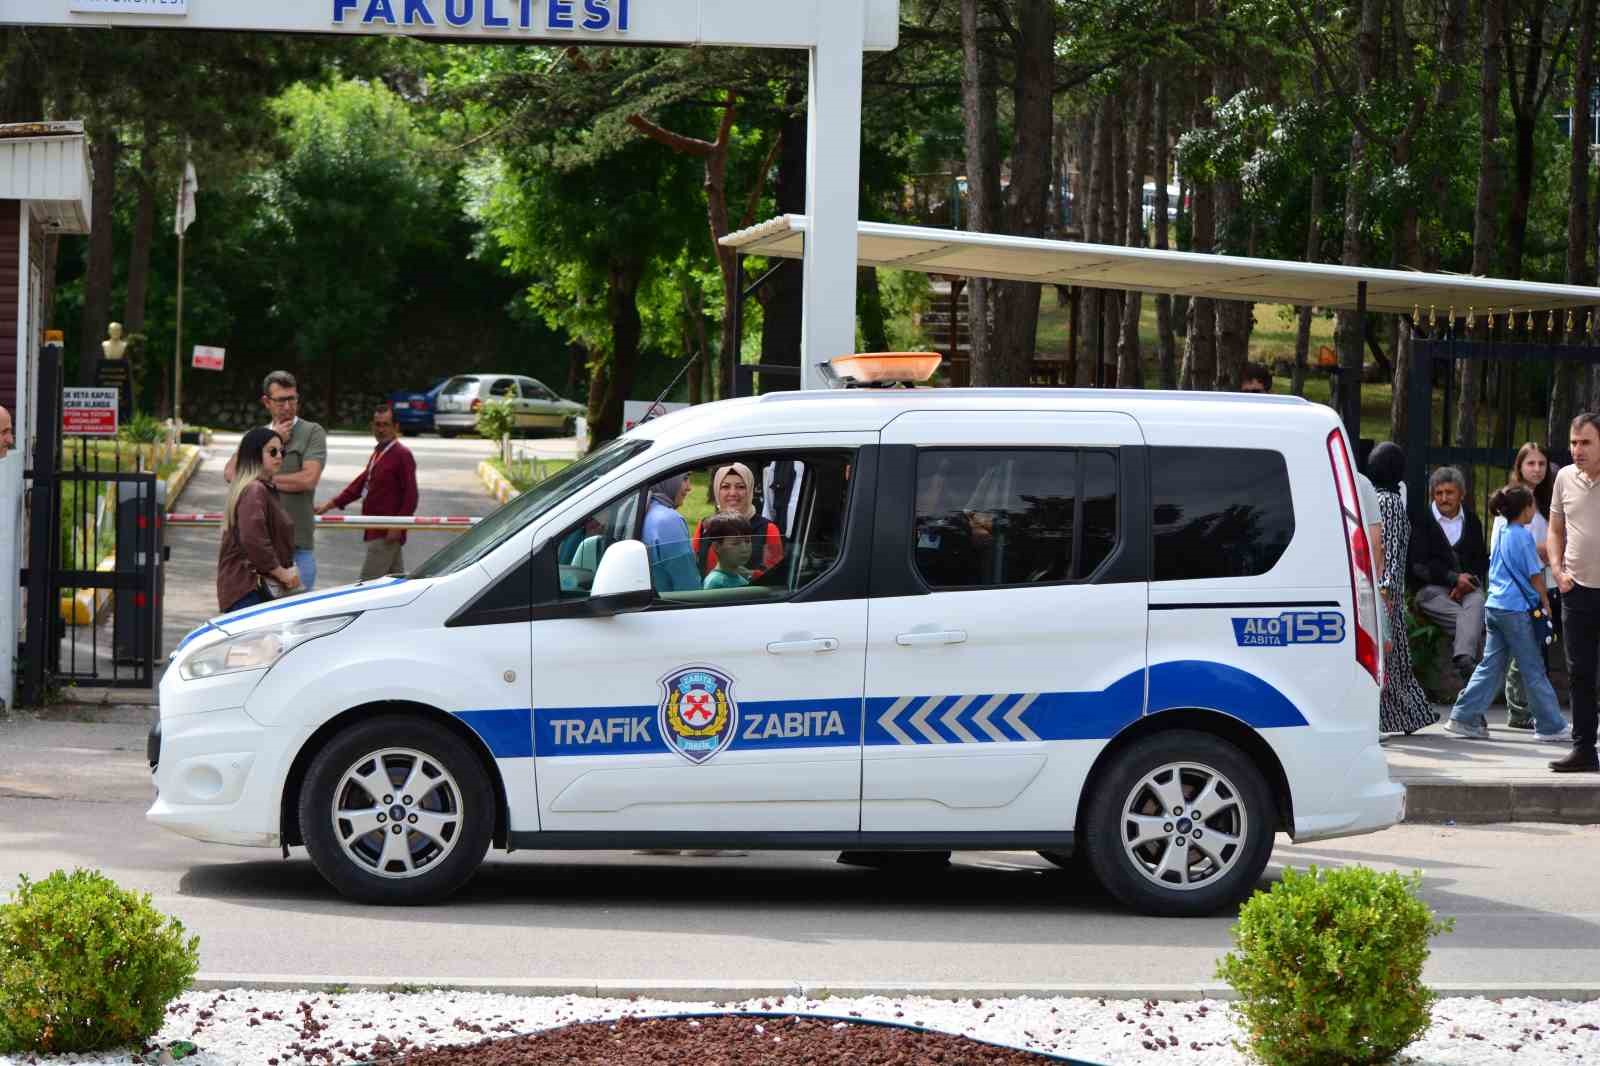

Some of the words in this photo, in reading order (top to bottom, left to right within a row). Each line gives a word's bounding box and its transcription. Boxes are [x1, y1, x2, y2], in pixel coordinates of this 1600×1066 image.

[1244, 618, 1280, 634] ALO
[1281, 614, 1343, 641] 153
[1243, 635, 1281, 645] ZABITA
[682, 674, 712, 684] ZABITA
[743, 711, 844, 738] ZABITA
